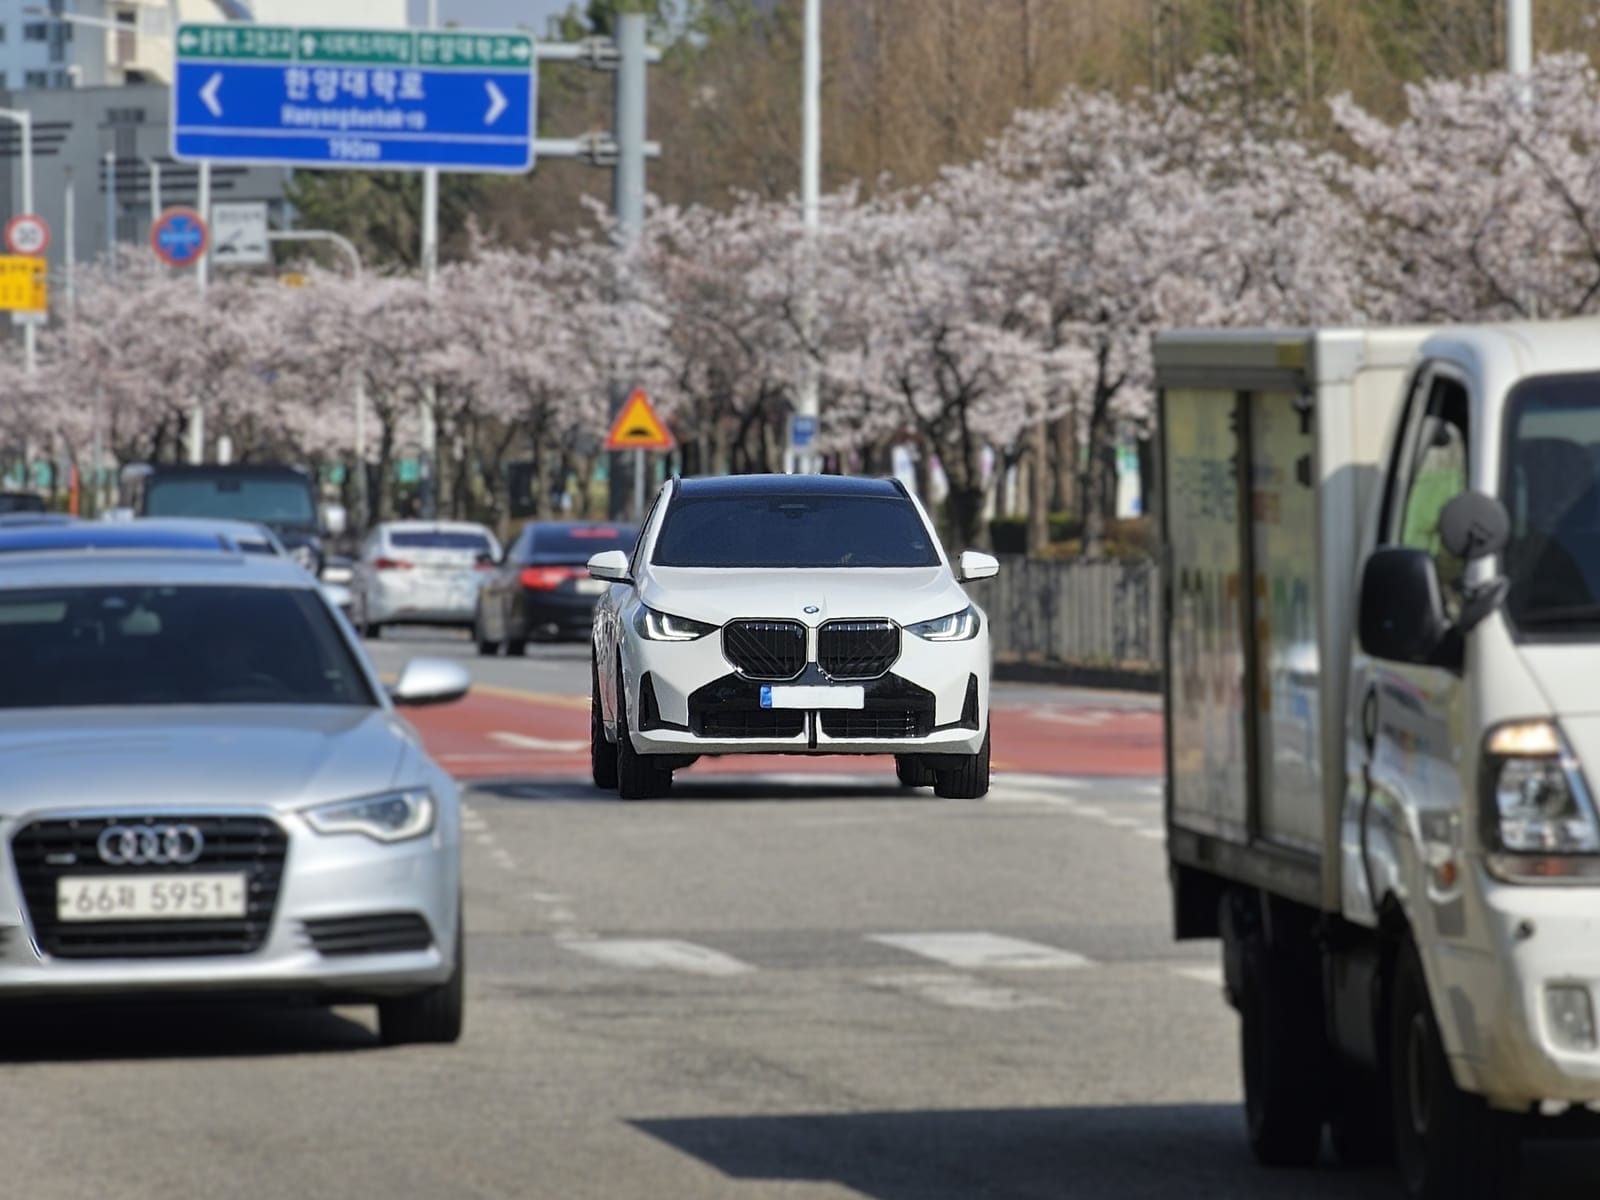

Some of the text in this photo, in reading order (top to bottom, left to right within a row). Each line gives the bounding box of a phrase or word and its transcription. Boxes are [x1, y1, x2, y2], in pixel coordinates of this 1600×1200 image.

[420, 37, 509, 63] 한양대학교
[284, 68, 427, 104] 한양대학로
[150, 881, 223, 911] 5951
